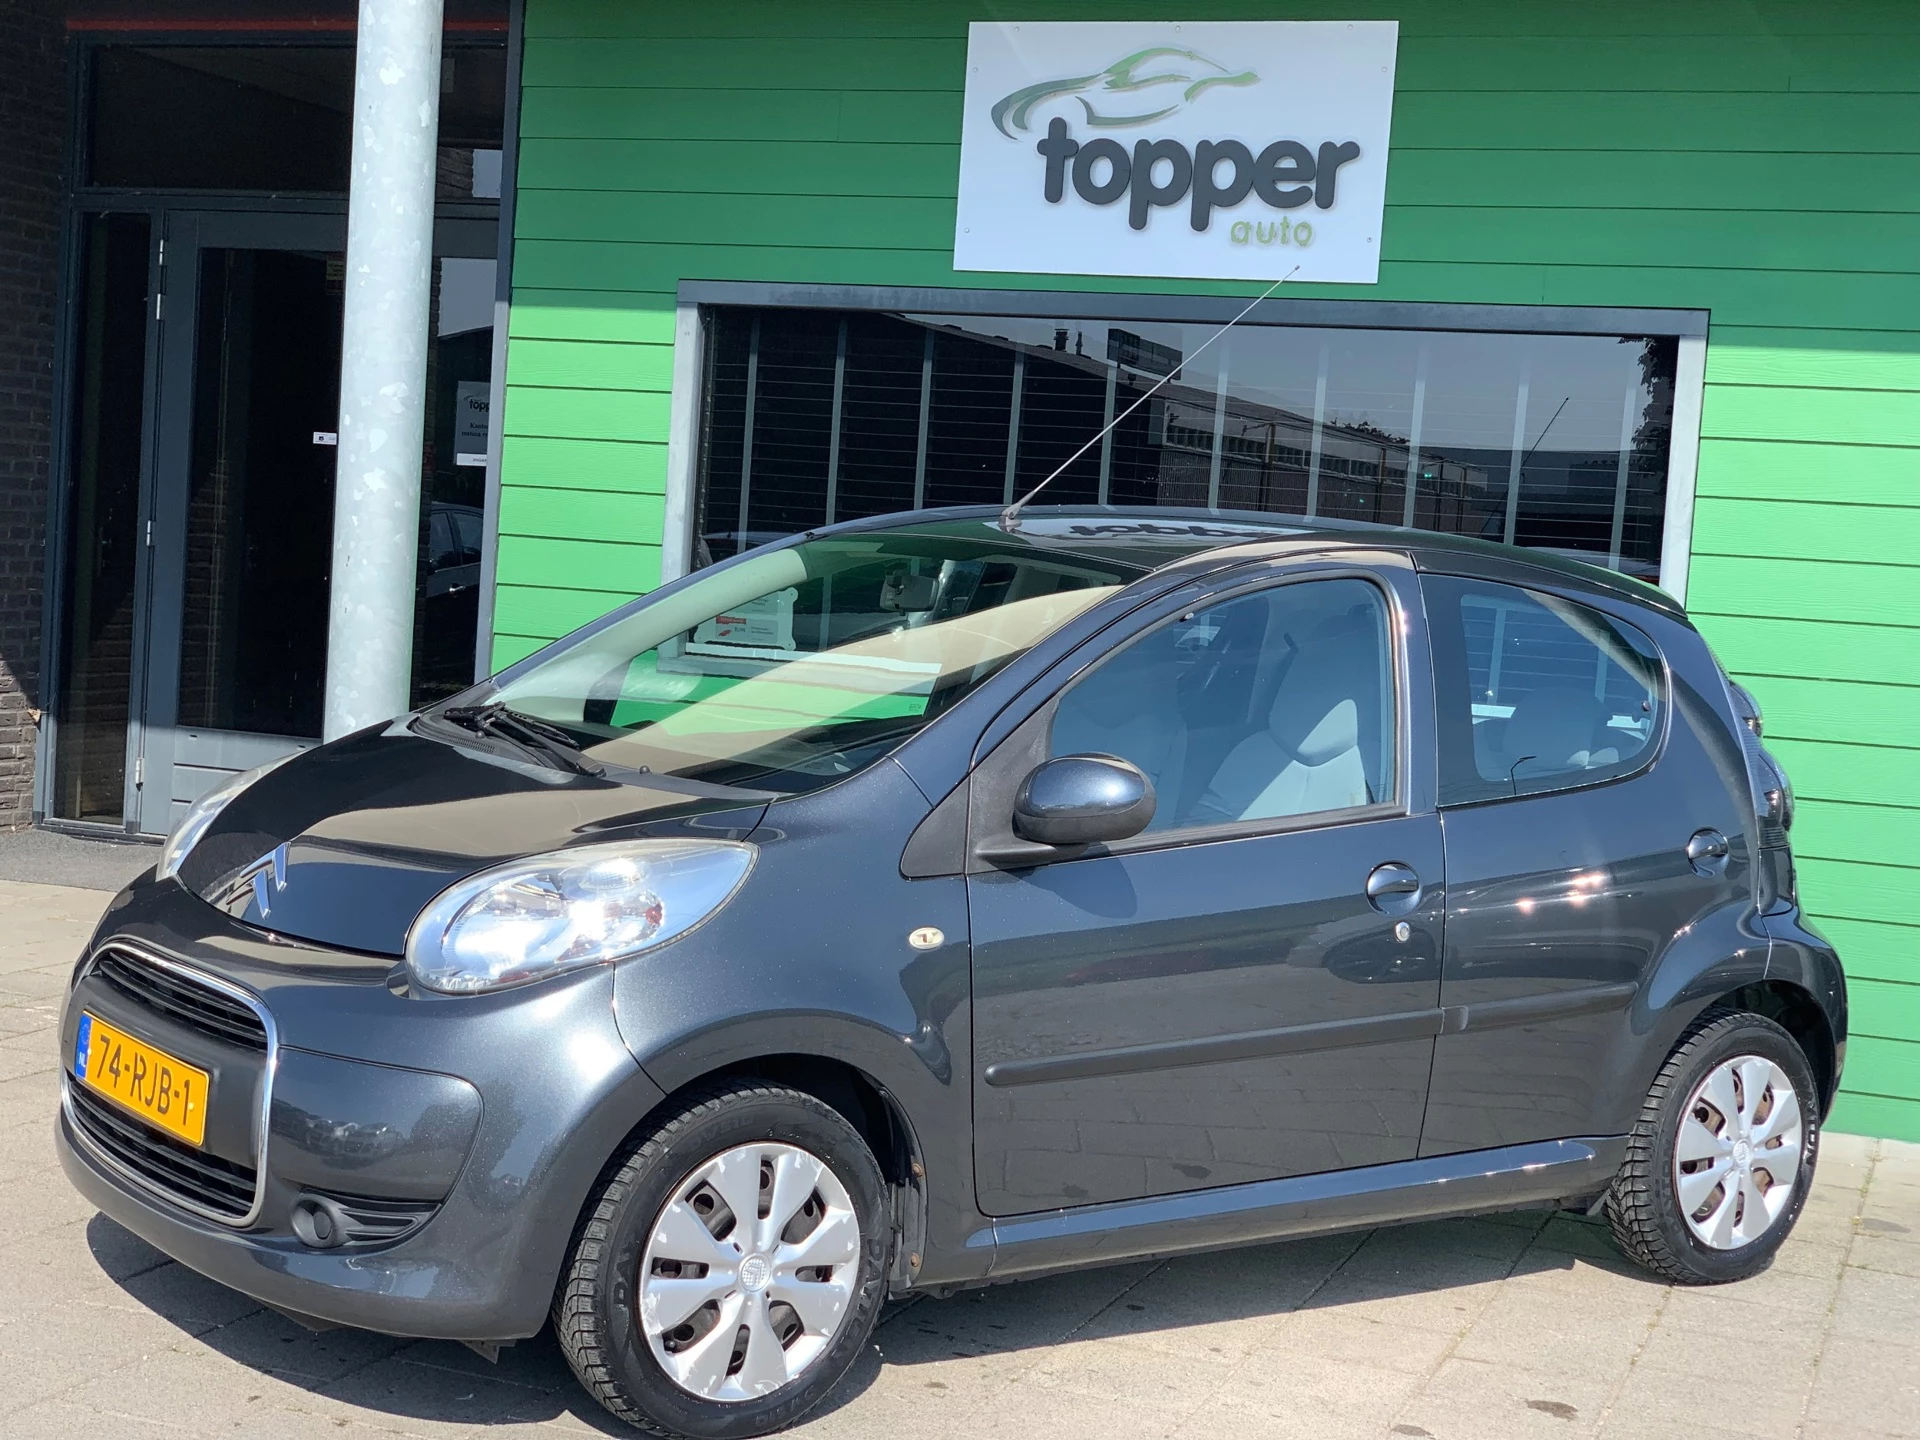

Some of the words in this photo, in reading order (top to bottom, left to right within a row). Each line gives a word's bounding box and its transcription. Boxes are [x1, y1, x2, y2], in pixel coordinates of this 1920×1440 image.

[1036, 116, 1361, 232] topper
[1230, 216, 1313, 246] auto
[78, 1050, 87, 1068] NL
[96, 1034, 191, 1126] 74-RJB-1
